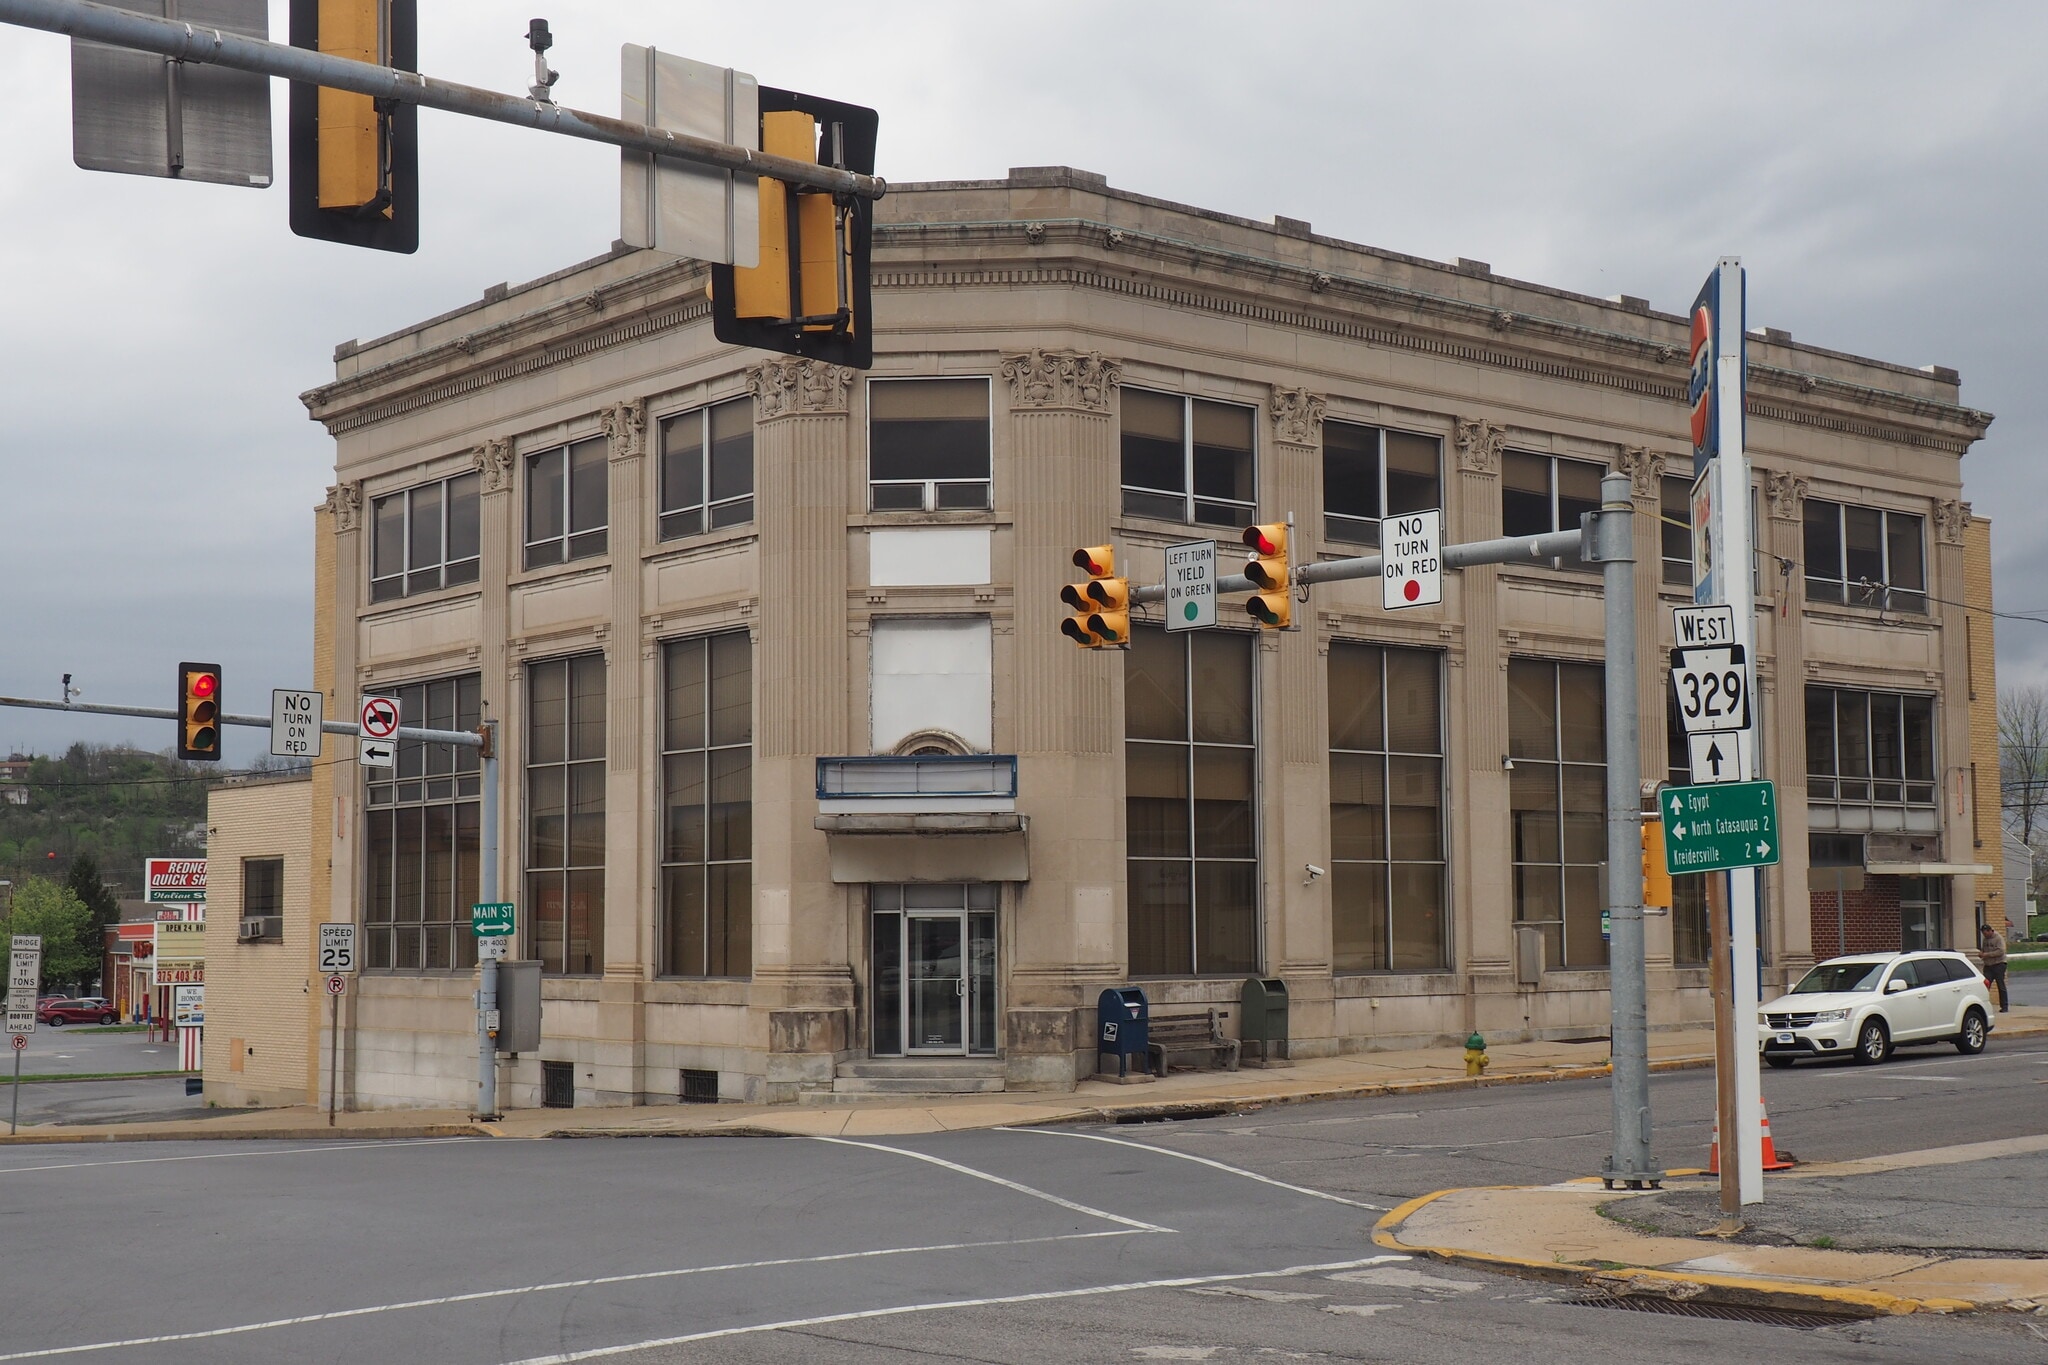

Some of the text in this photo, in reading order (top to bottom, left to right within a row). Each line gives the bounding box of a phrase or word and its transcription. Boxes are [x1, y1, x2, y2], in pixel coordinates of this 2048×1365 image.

[1399, 517, 1423, 537] NO
[1395, 539, 1429, 557] TURN
[1169, 548, 1212, 565] LEFT TURN
[1177, 565, 1205, 582] YIELD
[1386, 558, 1438, 578] ON RED
[1170, 583, 1211, 599] ON GREEN
[1680, 615, 1727, 642] WEST
[1683, 670, 1741, 718] 329
[285, 696, 310, 711] NO
[283, 713, 311, 725] TURN
[289, 726, 304, 738] ON
[285, 740, 307, 751] RED
[1688, 789, 1768, 813] Egypt 2
[1691, 815, 1770, 837] North Catasauqua 2
[1673, 842, 1752, 866] Kreidersville 2
[152, 874, 188, 886] QUICK
[473, 905, 513, 919] MAIN ST
[165, 924, 182, 932] OPEN
[183, 924, 192, 932] 24
[322, 928, 352, 937] SPEED
[13, 939, 38, 947] BRIDGE
[325, 938, 349, 947] LIMIT
[490, 939, 508, 947] 4003
[322, 948, 351, 967] 25
[13, 977, 35, 986] TONS
[157, 970, 172, 982] 375
[175, 970, 190, 982] 403
